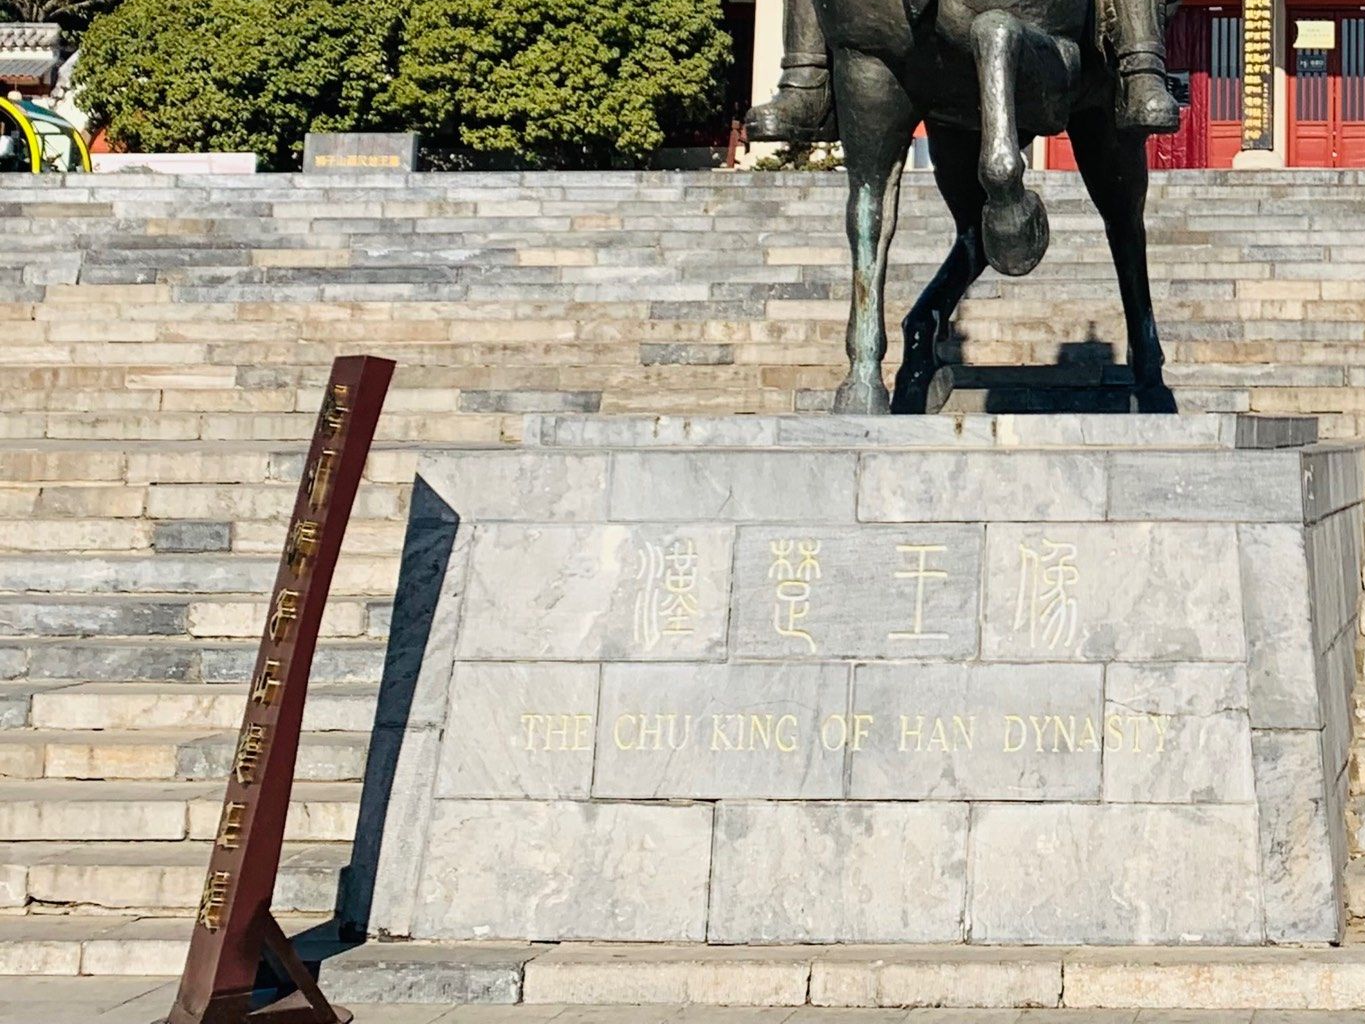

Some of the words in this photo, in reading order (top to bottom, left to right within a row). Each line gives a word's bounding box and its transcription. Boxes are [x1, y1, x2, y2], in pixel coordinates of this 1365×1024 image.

[521, 713, 593, 751] THE
[613, 714, 691, 751] CHU
[710, 713, 798, 752] KING
[821, 714, 874, 751] OF
[898, 714, 977, 752] HAN
[1002, 714, 1174, 752] DYNASTY
